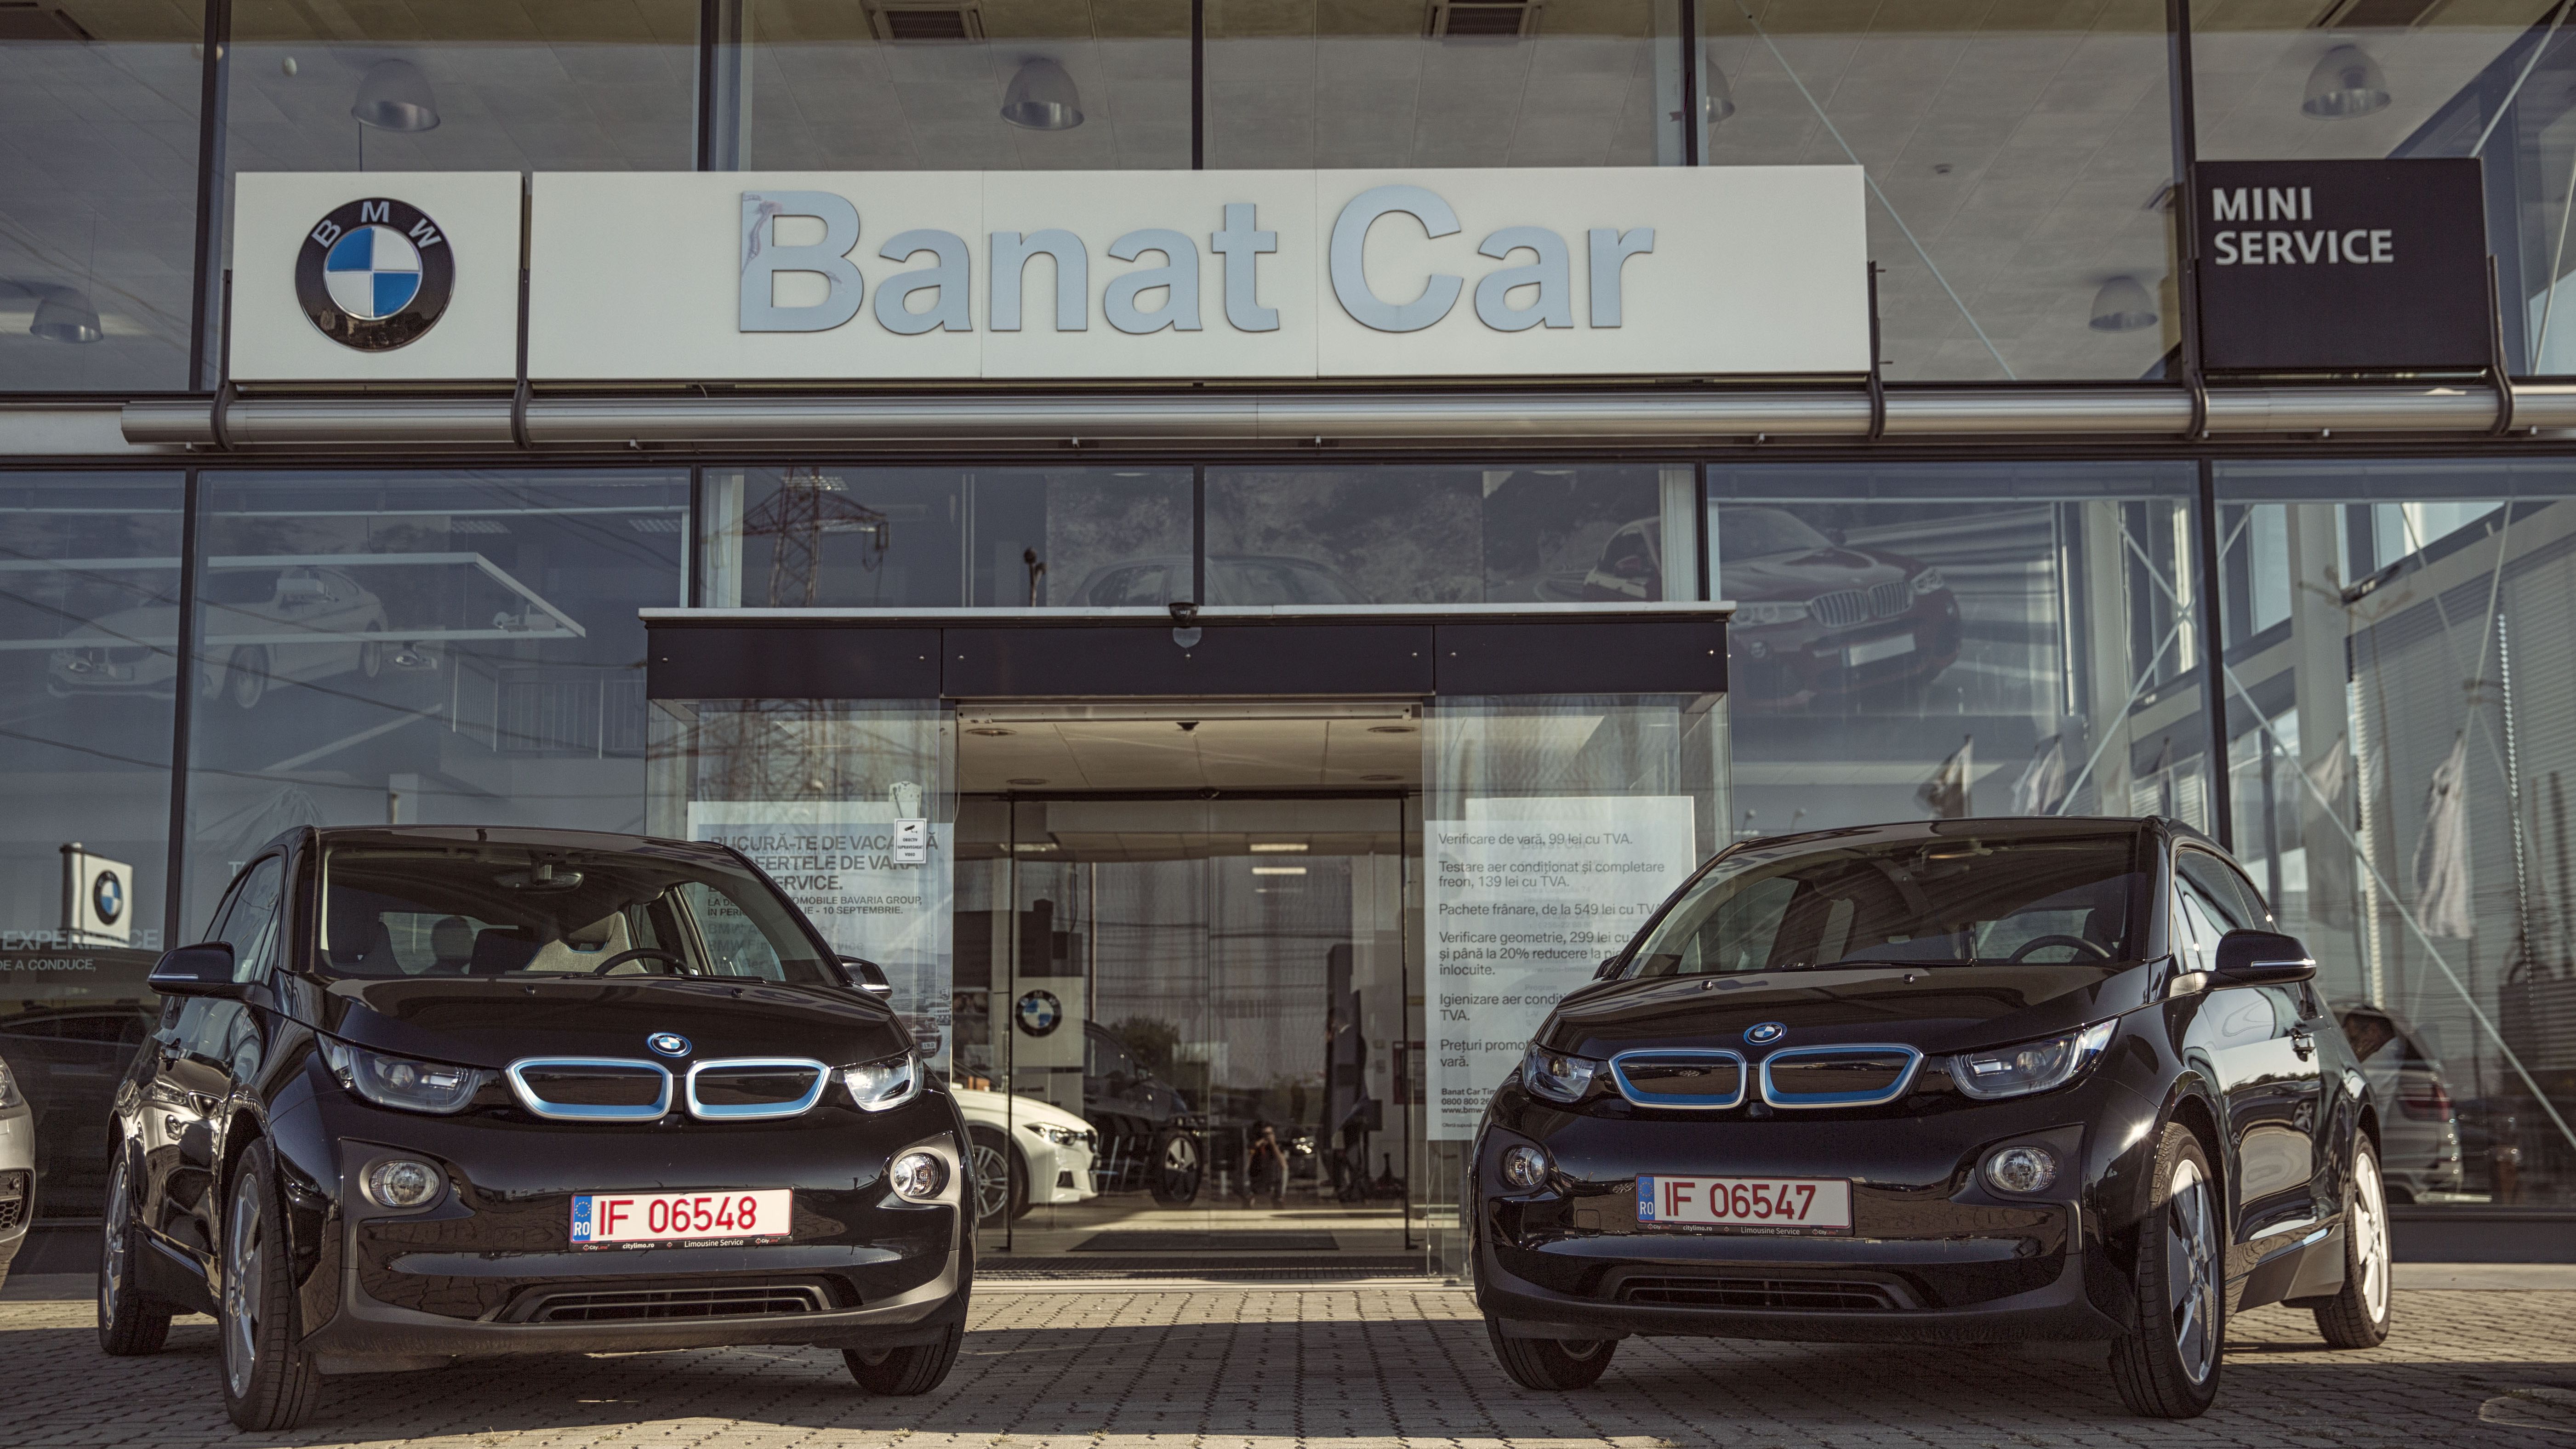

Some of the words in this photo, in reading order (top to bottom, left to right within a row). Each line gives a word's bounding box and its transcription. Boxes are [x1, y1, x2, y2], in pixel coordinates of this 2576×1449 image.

[2212, 187, 2312, 221] MINI
[311, 200, 442, 249] BMW
[2214, 229, 2394, 265] SERVICE
[740, 190, 1280, 335] Banat
[1329, 183, 1654, 332] Car
[822, 836, 846, 850] DE
[849, 832, 938, 850] VACAĂ
[1438, 833, 1495, 844] Verificare
[1499, 833, 1514, 844] de
[1517, 833, 1545, 845] vară,
[1549, 833, 1564, 844] 99
[1568, 833, 1581, 844] lei
[1585, 836, 1600, 844] cu
[1603, 833, 1632, 844] TVA.
[753, 856, 836, 870] FERTELE
[841, 856, 865, 870] DE
[1439, 861, 1484, 872] Testare
[1487, 863, 1506, 872] aer
[1596, 861, 1664, 874] completare
[773, 875, 843, 890] ERVICE.
[1439, 876, 1474, 889] freon,
[1478, 876, 1501, 887] 139
[1505, 876, 1519, 887] lei
[1522, 878, 1537, 887] cu
[1540, 876, 1569, 887] TVA.
[886, 896, 922, 905] GROUP,
[1439, 904, 1489, 915] Pachete
[1493, 904, 1538, 917] frânare,
[1542, 904, 1557, 915] de
[1562, 904, 1571, 915] la
[1574, 904, 1598, 915] 549
[1602, 904, 1615, 915] lei
[1619, 906, 1633, 915] cu
[1637, 904, 1661, 915] TV
[1439, 931, 1497, 942] Verificare
[1500, 932, 1566, 945] geometrie,
[1570, 931, 1594, 942] 299
[1598, 931, 1612, 942] lei
[1614, 934, 1629, 942] cu
[1453, 948, 1483, 961] până
[1487, 948, 1497, 958] la
[1500, 948, 1529, 958] 20%
[1533, 948, 1587, 958] reducere
[1591, 948, 1602, 958] la
[15, 960, 24, 971] A
[28, 959, 96, 972] CONDUCE,
[1439, 964, 1495, 975] înlocuite.
[1440, 993, 1499, 1007] Igienizare
[1502, 996, 1522, 1004] aer
[1440, 1010, 1470, 1021] TVA.
[1441, 1056, 1469, 1067] vară.
[1640, 1201, 1653, 1215] RO
[1665, 1182, 1695, 1216] IF
[1710, 1183, 1816, 1220] 06547
[599, 1200, 634, 1236] IF
[649, 1196, 757, 1233] 06548
[574, 1221, 590, 1236] RO
